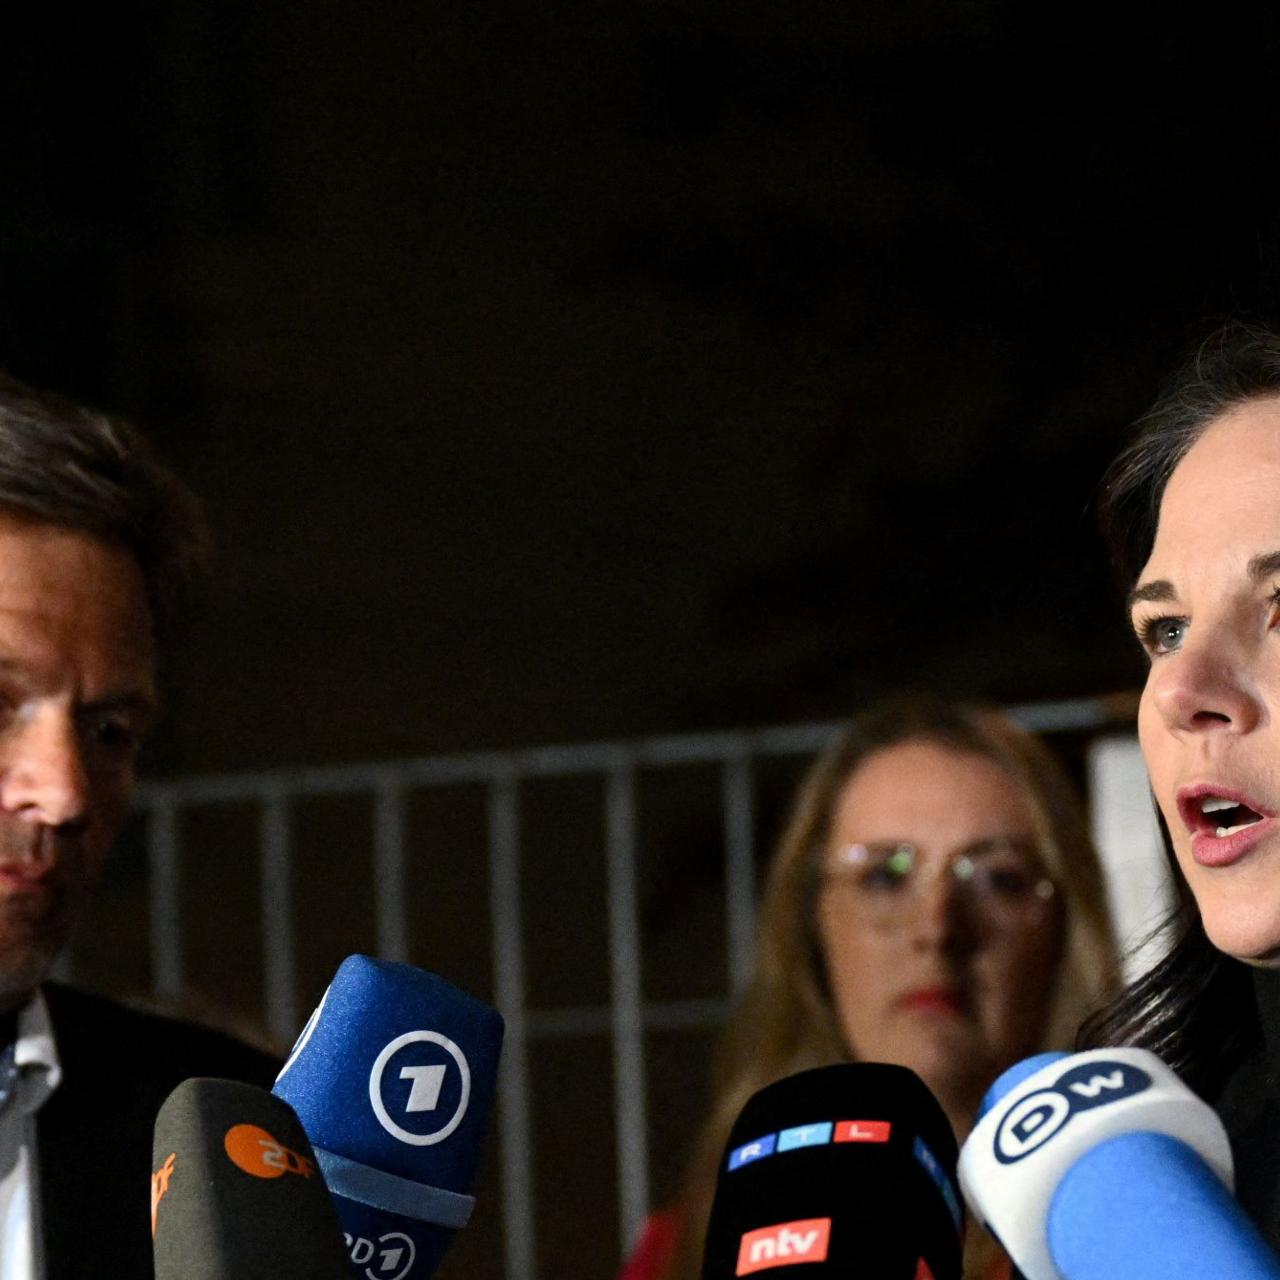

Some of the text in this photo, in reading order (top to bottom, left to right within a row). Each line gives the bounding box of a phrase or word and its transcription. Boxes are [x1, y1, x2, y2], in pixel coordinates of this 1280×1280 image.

[1011, 1069, 1125, 1144] DW
[739, 1123, 873, 1162] RTL
[750, 1227, 819, 1263] ntv
